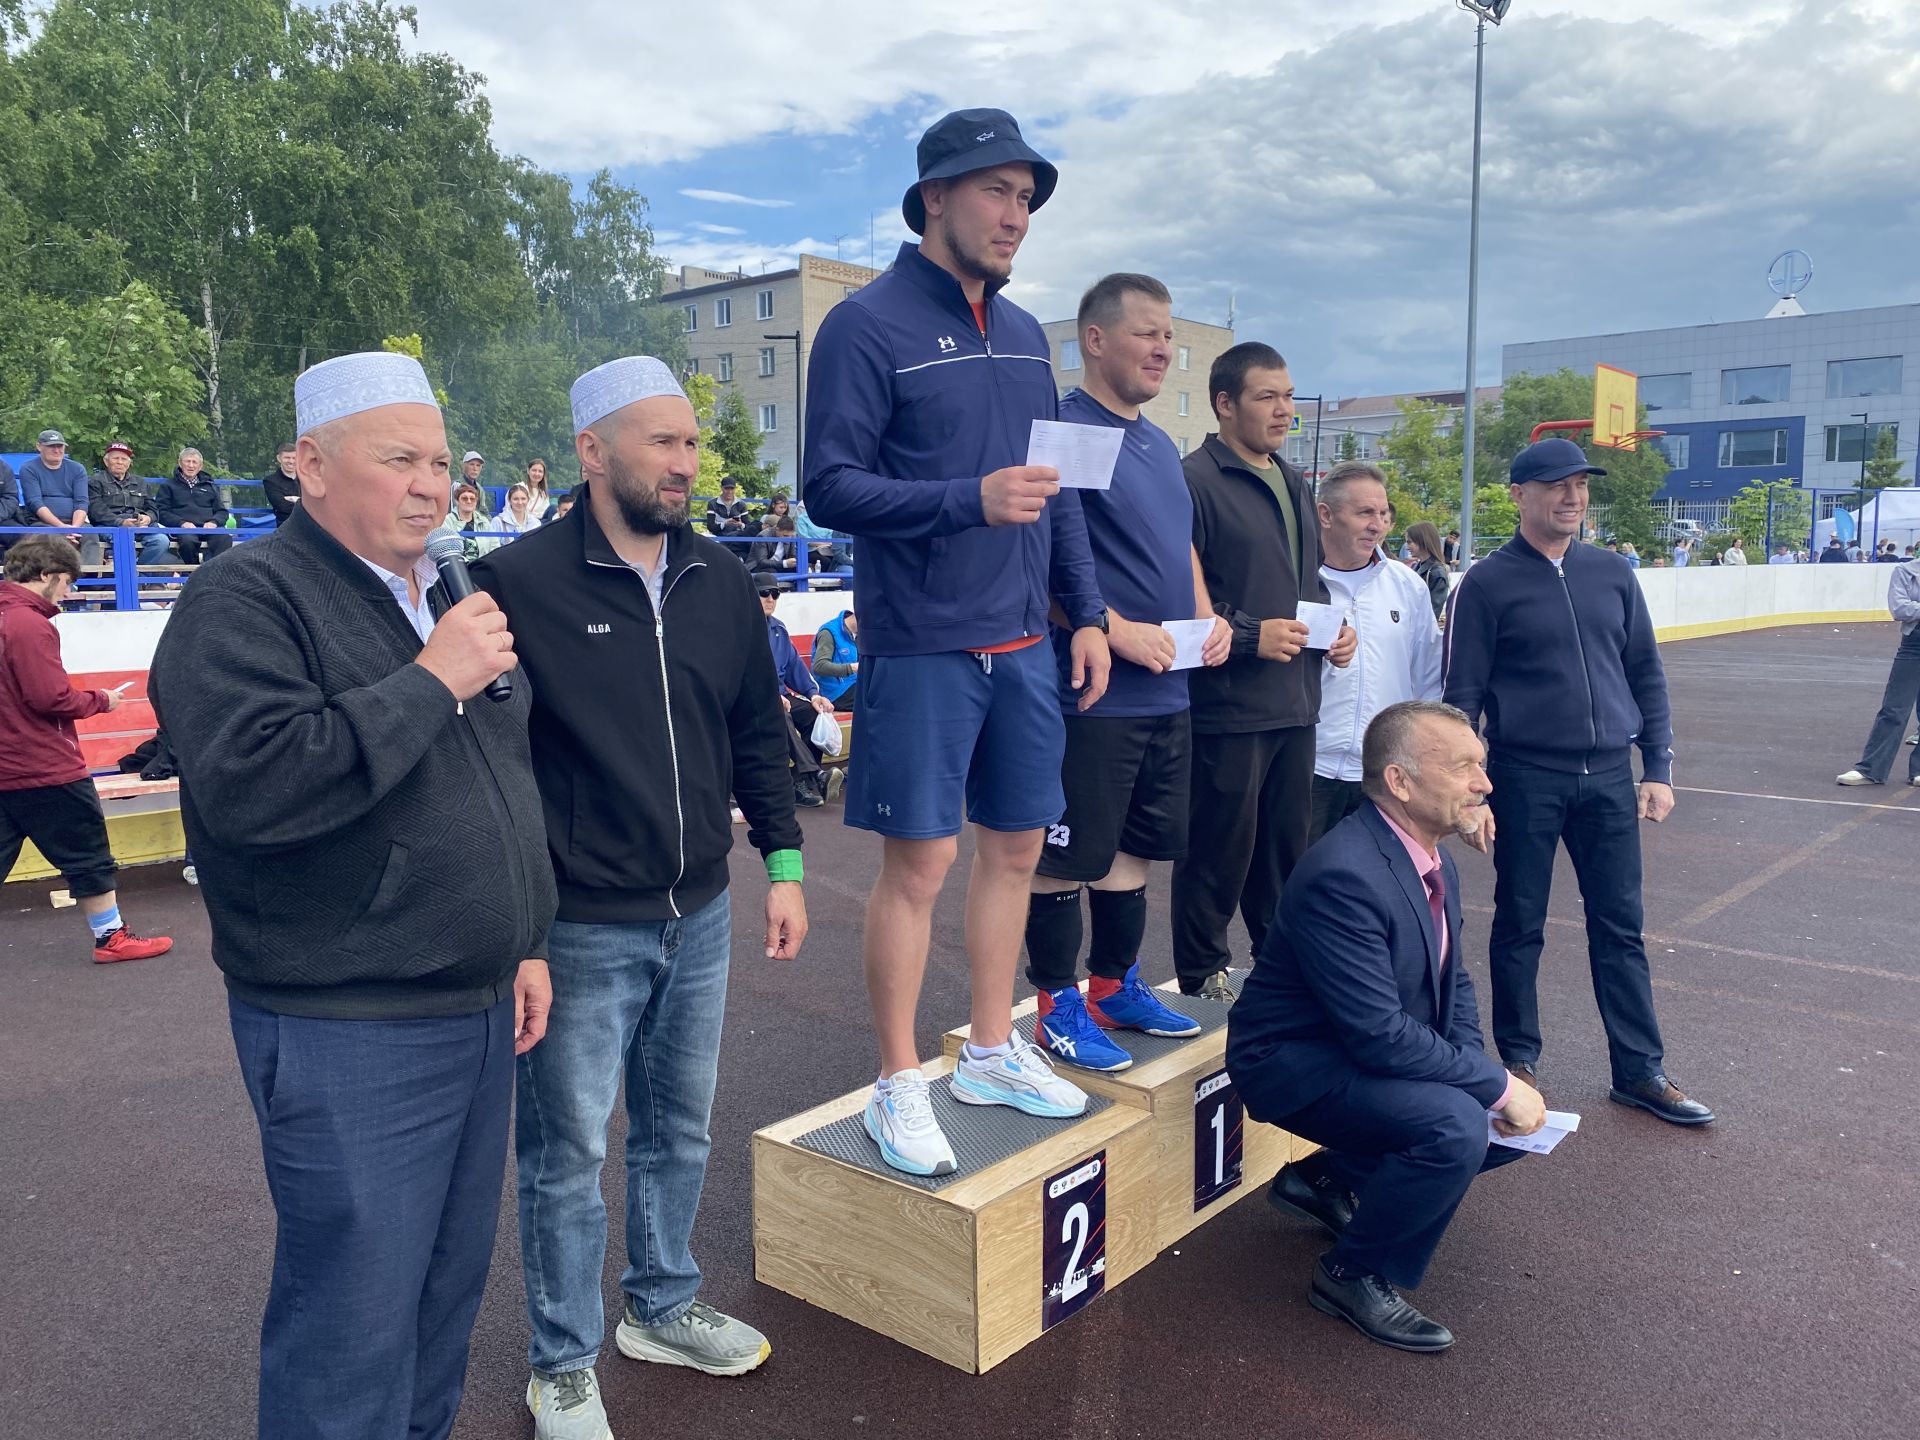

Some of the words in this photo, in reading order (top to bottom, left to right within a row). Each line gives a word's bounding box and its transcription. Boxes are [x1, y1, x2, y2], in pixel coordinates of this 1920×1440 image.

[587, 623, 611, 634] ALGA
[1047, 824, 1070, 847] 23
[1211, 1103, 1225, 1186] 1
[1061, 1202, 1089, 1304] 2
